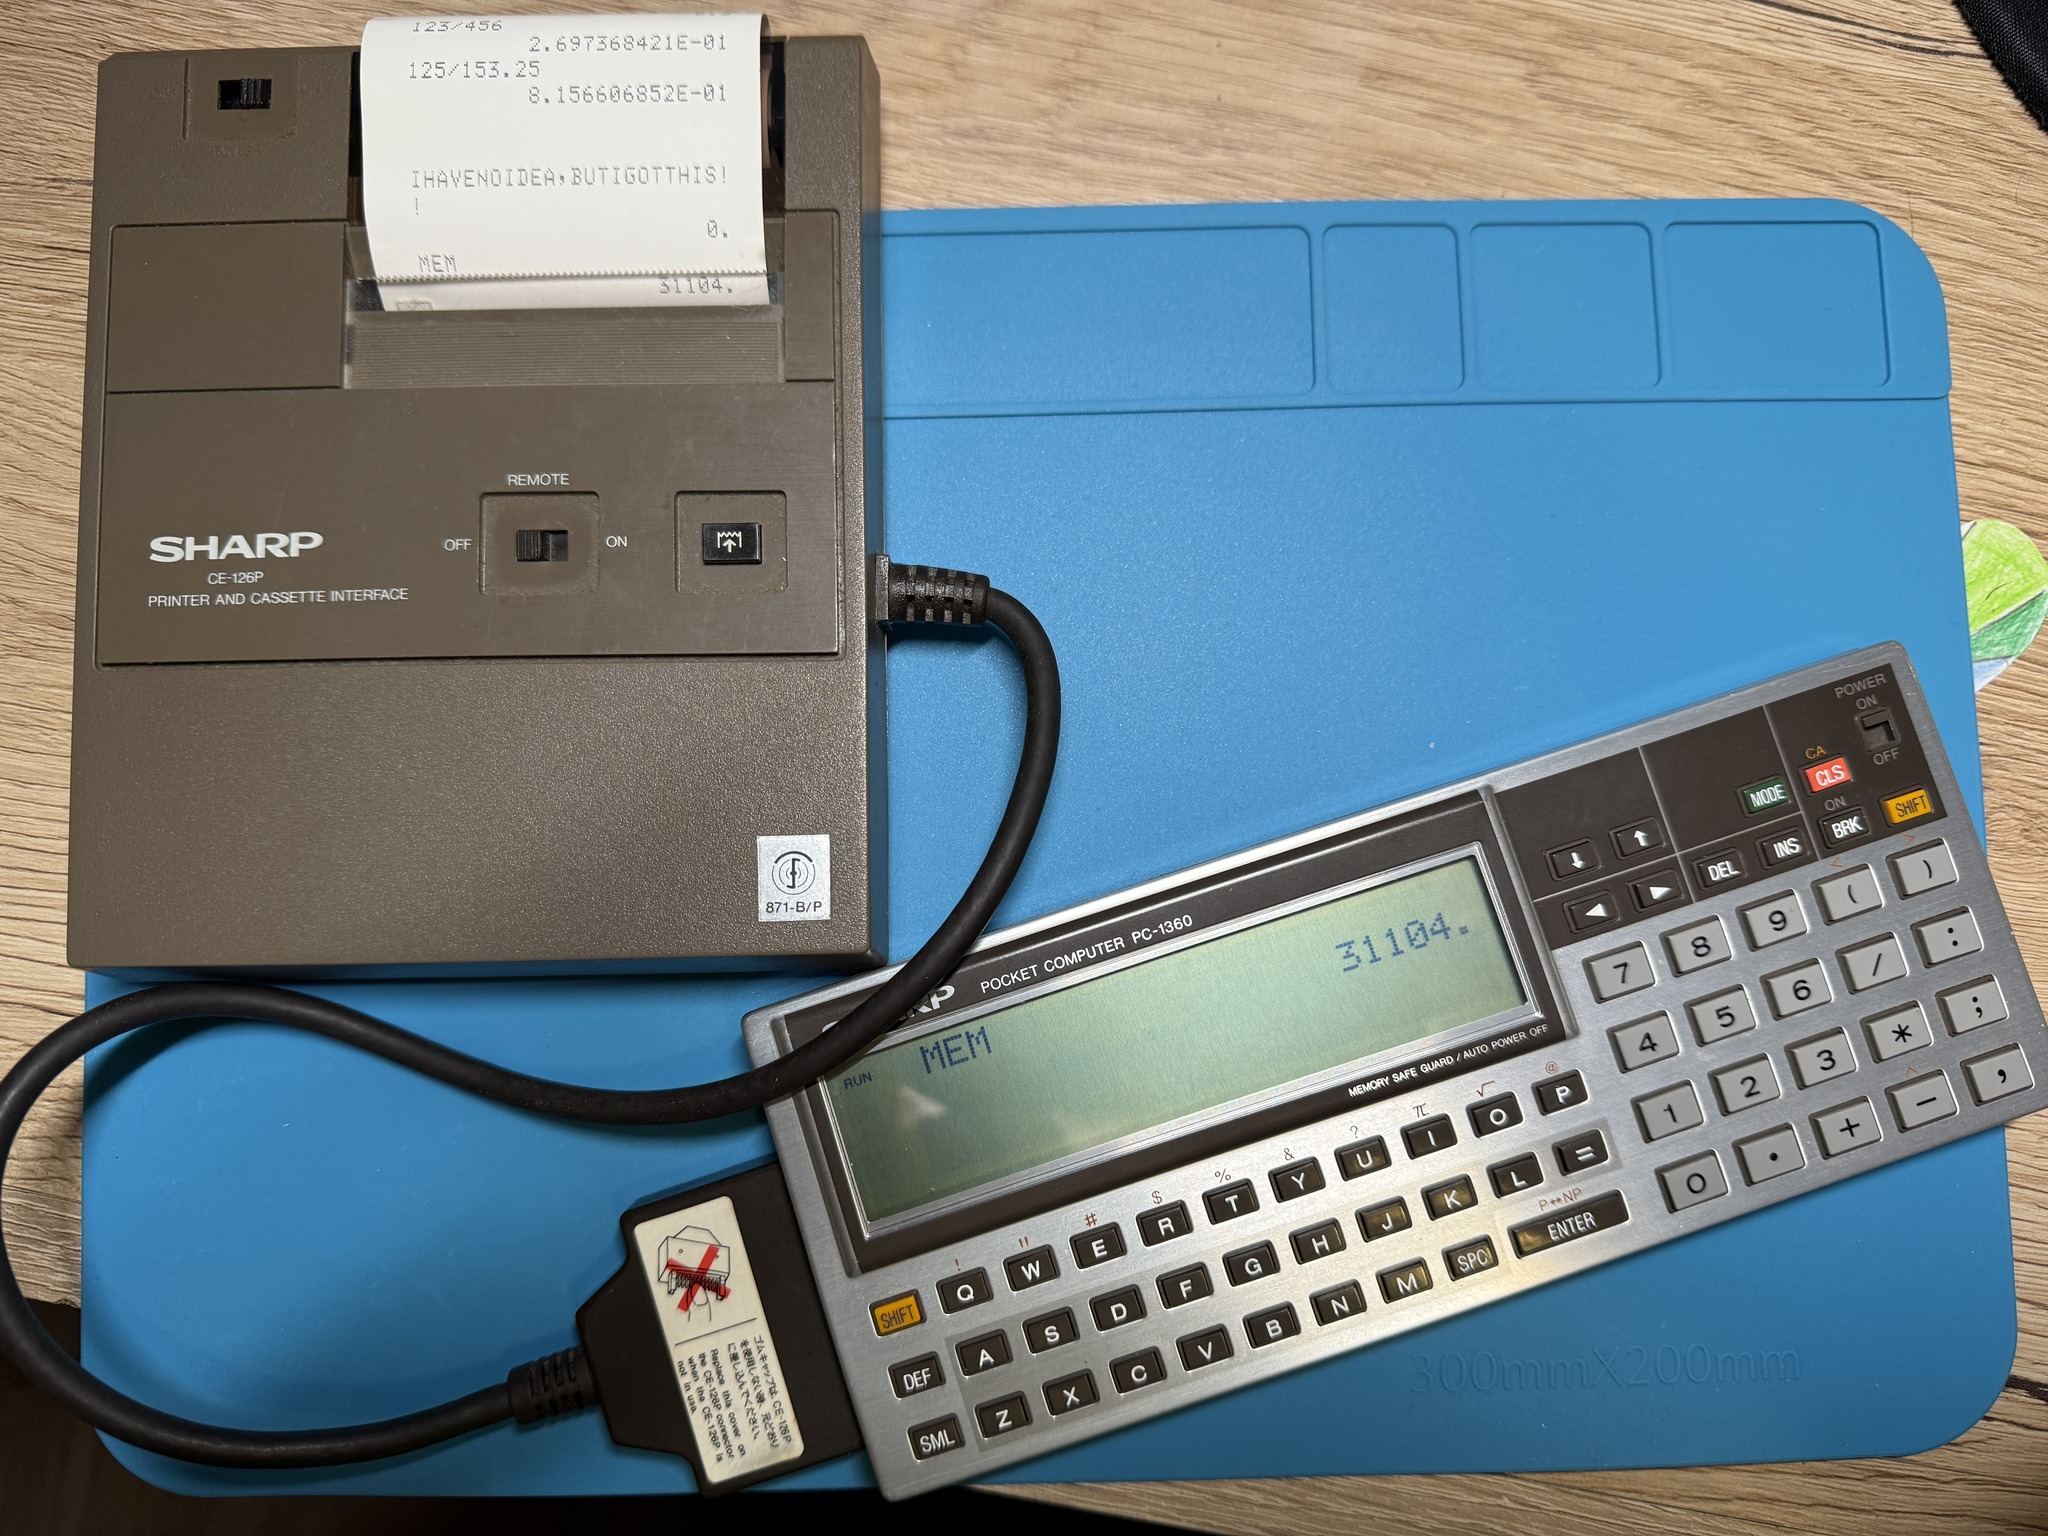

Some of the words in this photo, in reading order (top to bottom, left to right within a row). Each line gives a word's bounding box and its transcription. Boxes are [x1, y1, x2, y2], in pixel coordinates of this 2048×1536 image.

[412, 20, 503, 32] 123/456
[529, 35, 727, 52] 2.697368421E-01
[409, 61, 540, 79] 125/153.25
[529, 85, 727, 104] 8.156606852E-01
[412, 167, 728, 189] IHAVENOIDEA,BUTIGOTTHIS!
[418, 253, 458, 274] MEM
[659, 276, 734, 295] 31104.
[507, 473, 570, 487] REMOTE
[149, 531, 324, 563] SHARP
[444, 538, 472, 552] OFF
[606, 535, 628, 549] ON
[207, 571, 264, 586] CE-126P
[148, 594, 210, 608] PRINTER
[215, 593, 246, 606] AND
[251, 590, 326, 605] CASSETTE
[331, 588, 409, 603] INTERFACE
[1833, 673, 1887, 700] POWER
[1855, 695, 1879, 711] ON
[1805, 744, 1827, 760] CA
[1872, 748, 1900, 767] OFF
[1814, 764, 1845, 788] CLS
[1749, 783, 1787, 808] MODE
[1823, 795, 1847, 811] ON
[1894, 794, 1929, 819] SHIFT
[1831, 815, 1864, 840] BRK
[1773, 836, 1802, 860] INS
[1708, 860, 1740, 882] DEL
[765, 900, 823, 914] 871-B/P
[1768, 909, 1788, 932] 9
[1335, 912, 1470, 973] 31104.
[1691, 935, 1711, 958] 8
[980, 964, 1039, 995] POCKET
[1043, 936, 1126, 974] COMPUTER
[1130, 914, 1194, 946] PC-1360
[1612, 961, 1630, 984] 7
[1791, 978, 1812, 1001] 6
[1715, 1004, 1736, 1029] 5
[919, 1025, 993, 1074] MEM
[1638, 1031, 1658, 1053] 4
[1347, 1075, 1391, 1099] MEMORY
[1392, 1066, 1418, 1084] SAFE
[1420, 1054, 1455, 1074] GUARD
[1462, 1043, 1490, 1060] AUTO
[1490, 1030, 1527, 1051] POWER
[1529, 1023, 1549, 1037] OFF
[1544, 1060, 1560, 1074] @
[1816, 1048, 1837, 1072] 3
[843, 1070, 874, 1091] RUN
[1739, 1075, 1761, 1098] 2
[1554, 1084, 1573, 1104] P
[1488, 1108, 1507, 1126] O
[1662, 1102, 1677, 1125] 1
[1349, 1124, 1360, 1139] ?
[1355, 1152, 1373, 1171] U
[1213, 1167, 1232, 1183] %
[1290, 1172, 1306, 1192] Y
[1511, 1169, 1529, 1188] L
[1151, 1190, 1164, 1205] $
[1224, 1194, 1240, 1214] T
[1442, 1189, 1463, 1209] K
[1083, 1212, 1099, 1228] #
[1157, 1216, 1175, 1236] R
[1380, 1213, 1394, 1231] J
[1546, 1211, 1597, 1242] ENTER
[1091, 1238, 1108, 1259] E
[1311, 1234, 1330, 1255] H
[1020, 1259, 1042, 1281] W
[1244, 1256, 1261, 1275] G
[1456, 1249, 1489, 1273] SPC
[955, 1283, 975, 1303] Q
[1178, 1279, 1194, 1299] F
[1395, 1274, 1420, 1293] M
[1110, 1302, 1128, 1322] D
[1331, 1295, 1349, 1315] N
[880, 1304, 914, 1330] SHIFT
[1044, 1325, 1060, 1343] S
[1266, 1318, 1283, 1338] B
[978, 1348, 995, 1368] A
[1196, 1341, 1214, 1360] V
[677, 1360, 688, 1377] not
[684, 1381, 691, 1392] in
[1130, 1364, 1148, 1382] C
[1410, 1342, 1801, 1393] 300mmX200mm
[903, 1367, 932, 1392] DEF
[698, 1352, 707, 1367] the
[703, 1370, 722, 1411] CE-126P
[716, 1413, 735, 1458] connector
[710, 1348, 725, 1385] Replace
[722, 1390, 732, 1409] this
[728, 1412, 741, 1437] cover
[737, 1444, 746, 1456] on
[1062, 1386, 1080, 1407] X
[687, 1356, 700, 1382] when
[696, 1386, 706, 1402] the
[702, 1406, 721, 1449] CE-126P
[716, 1453, 723, 1463] is
[995, 1408, 1013, 1429] Z
[919, 1428, 956, 1452] SML
